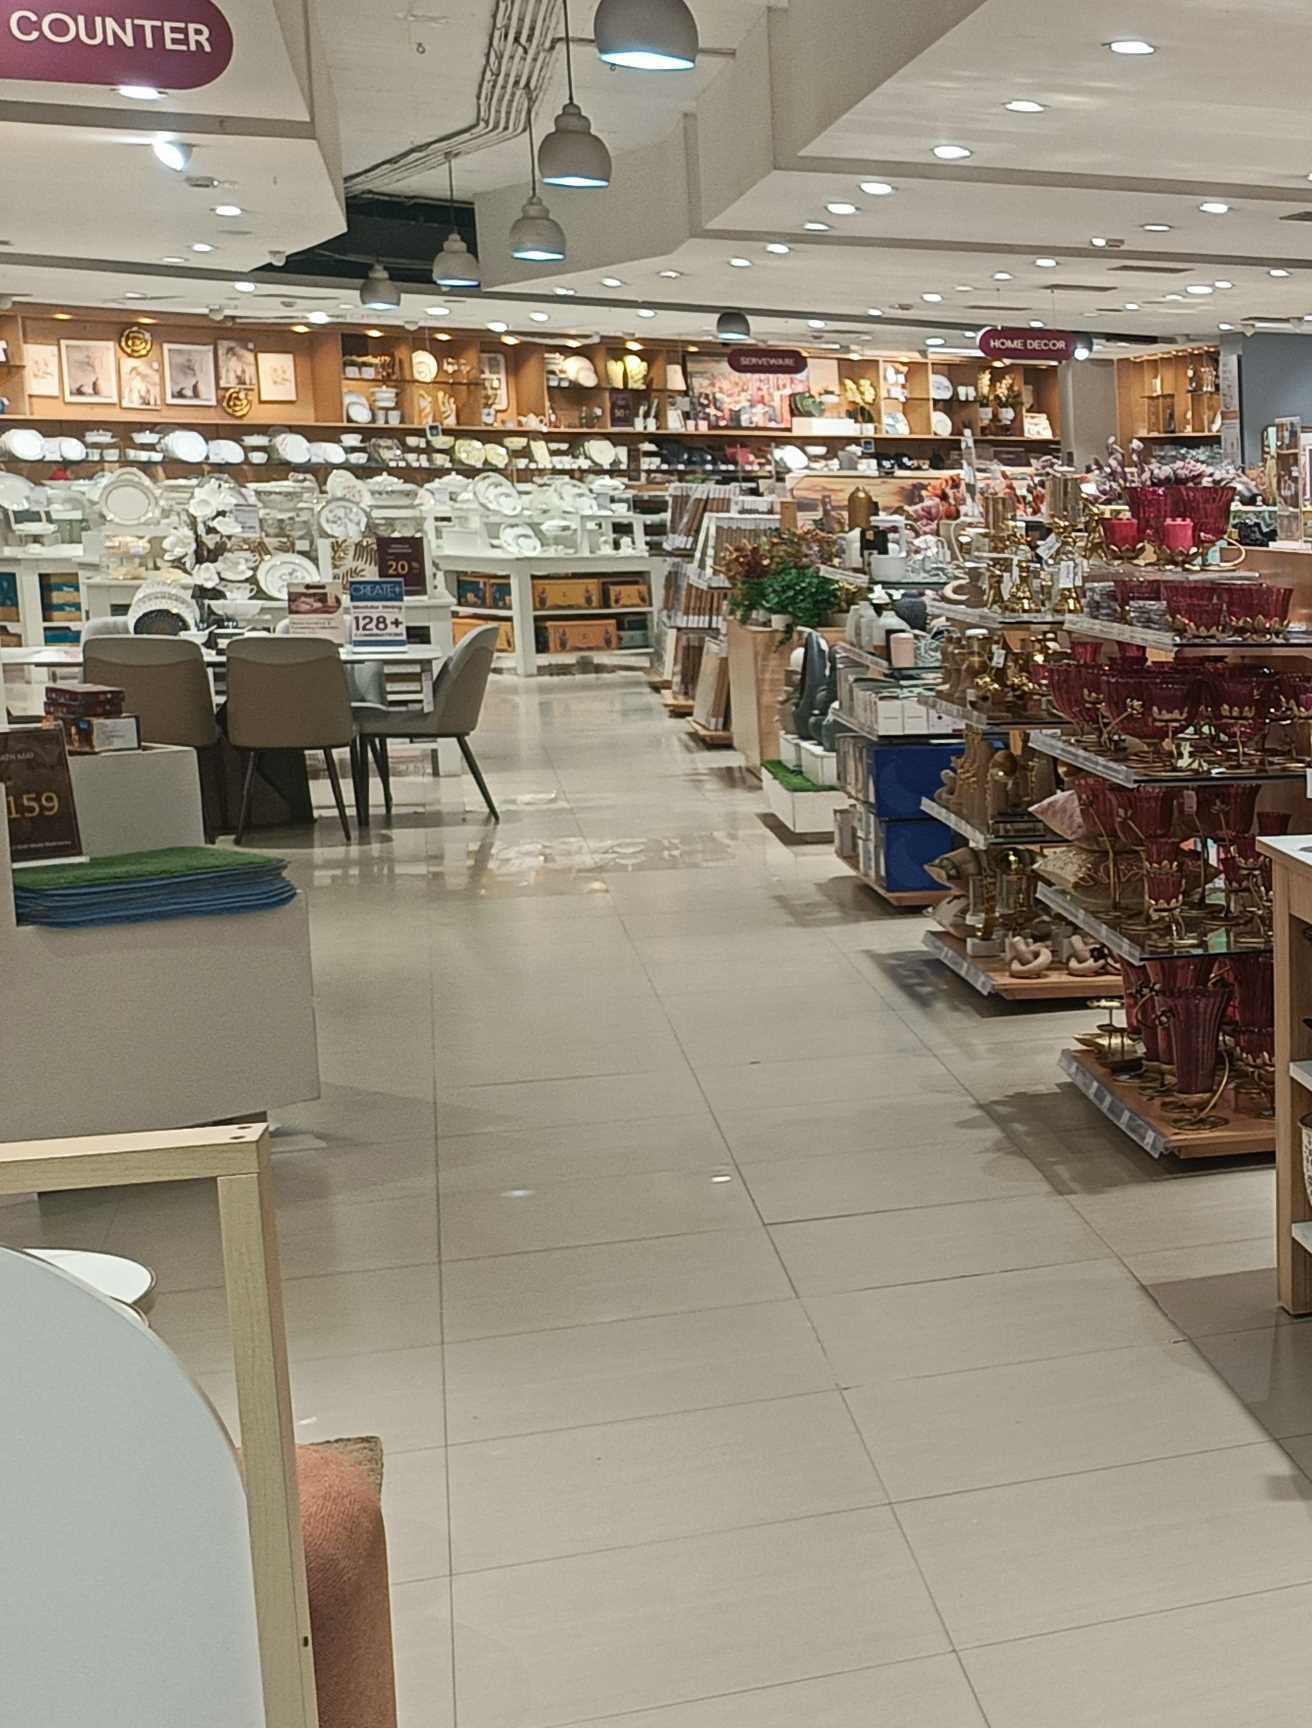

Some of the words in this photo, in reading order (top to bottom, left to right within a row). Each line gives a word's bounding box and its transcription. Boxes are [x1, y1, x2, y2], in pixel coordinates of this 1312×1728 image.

[9, 10, 212, 52] COUNTER
[990, 338, 1025, 350] HOME
[1026, 339, 1067, 351] DECOR
[741, 356, 796, 367] SERVEWARE
[387, 560, 409, 575] 20
[353, 615, 404, 632] 128+
[7, 792, 59, 819] 159
